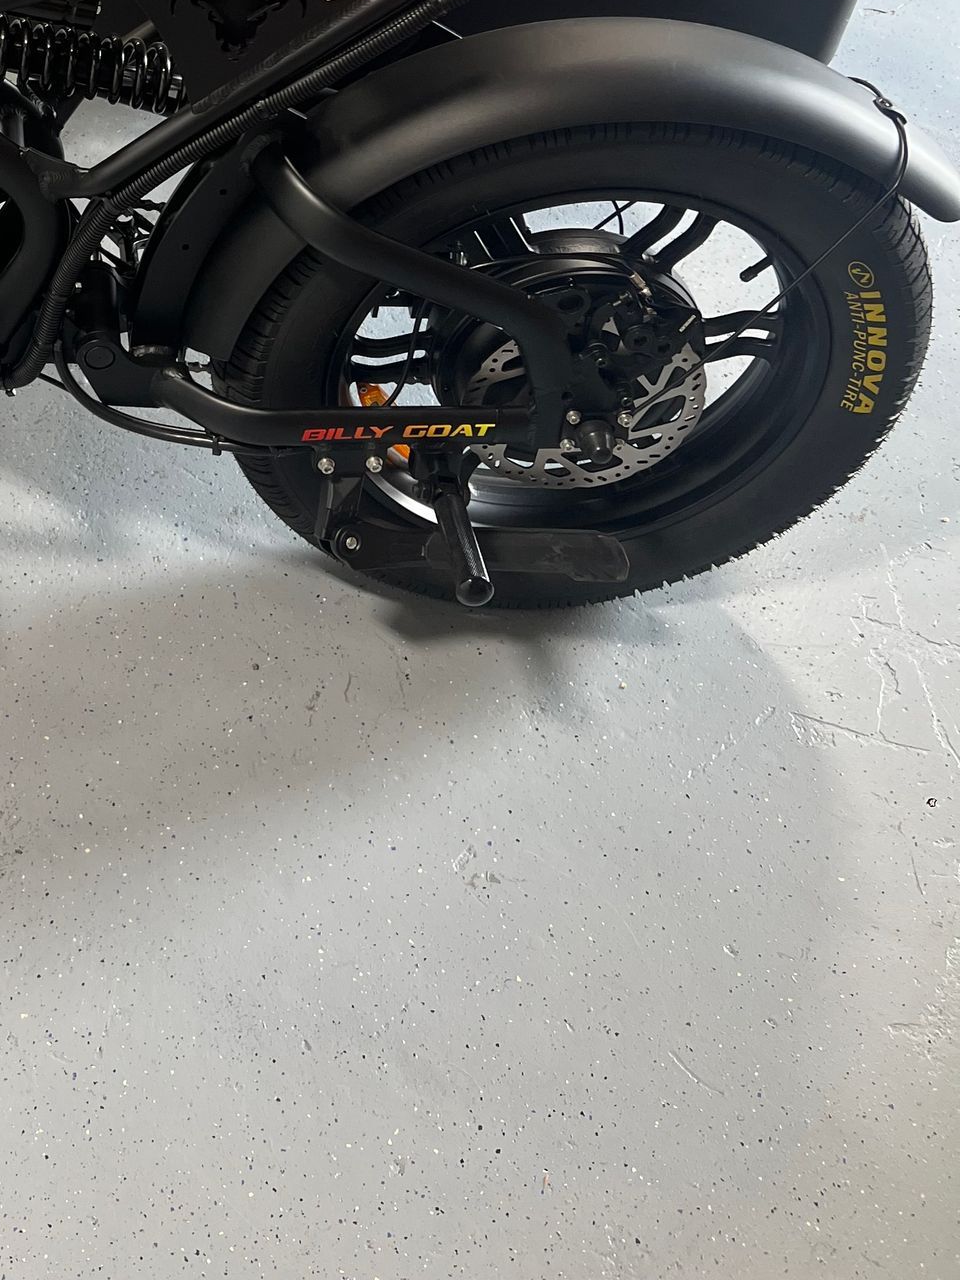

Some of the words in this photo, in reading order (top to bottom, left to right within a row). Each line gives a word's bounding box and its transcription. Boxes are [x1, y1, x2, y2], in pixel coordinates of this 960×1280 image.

[839, 291, 868, 412] ANTI-PUNC-TIRE
[853, 290, 888, 415] INNOVA
[301, 424, 395, 443] BILLY
[402, 422, 497, 439] GOAT
